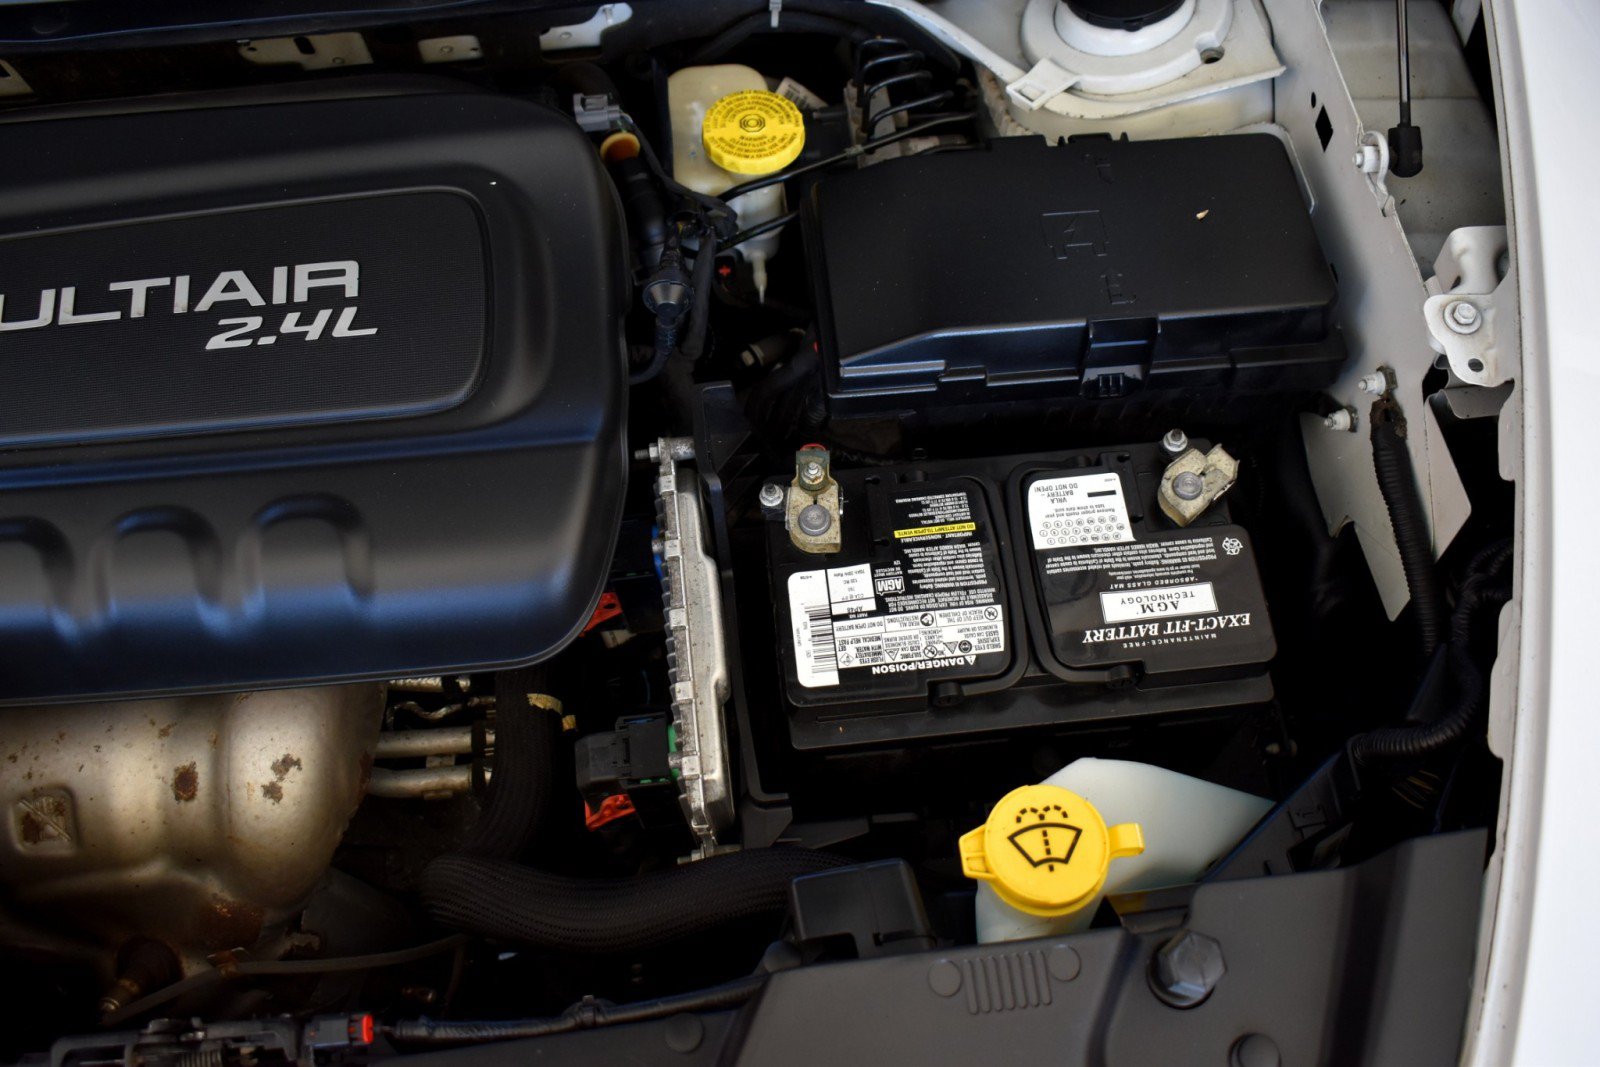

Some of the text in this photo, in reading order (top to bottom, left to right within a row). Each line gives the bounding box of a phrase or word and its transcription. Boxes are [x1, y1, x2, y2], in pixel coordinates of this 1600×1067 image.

[0, 260, 359, 331] ULTIAIR
[205, 306, 379, 350] 2.4L
[1045, 489, 1073, 497] BATTERY
[876, 578, 902, 591] AGM
[1119, 590, 1194, 604] TECHNOLOGY
[1079, 612, 1252, 643] EXACT-FIT BATTERY
[1121, 633, 1217, 647] MAINTENANCE-FREE
[855, 650, 882, 658] IMMEDIATELY
[871, 656, 964, 674] DANGER/POISON
